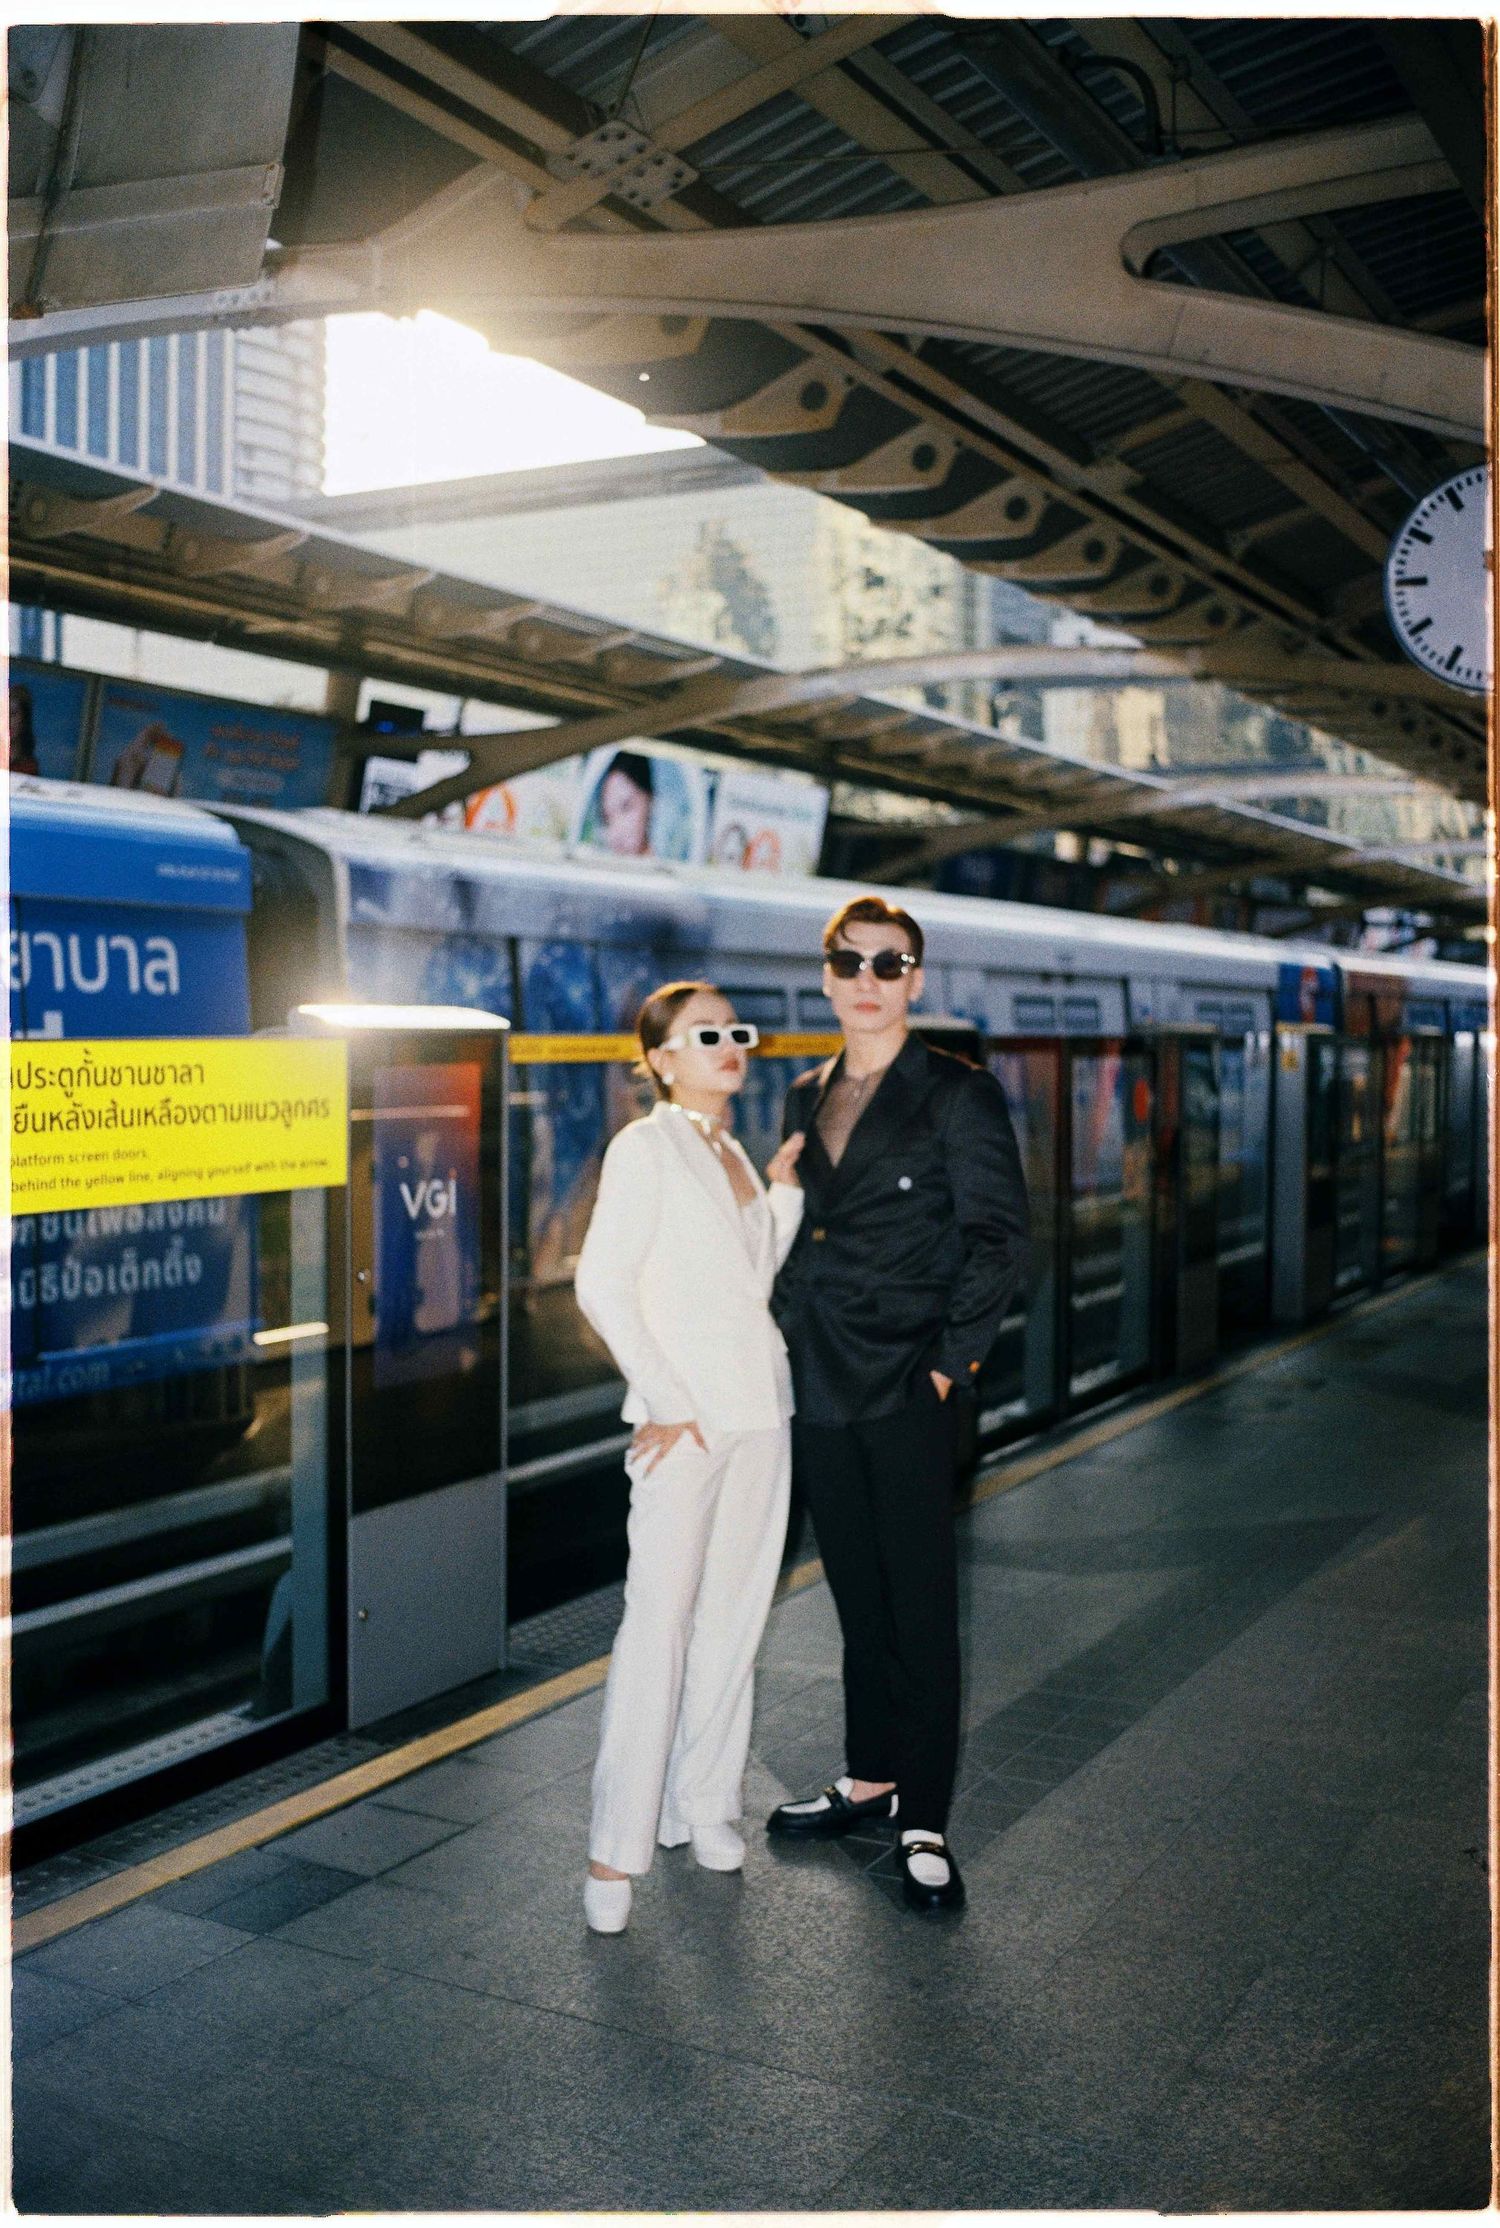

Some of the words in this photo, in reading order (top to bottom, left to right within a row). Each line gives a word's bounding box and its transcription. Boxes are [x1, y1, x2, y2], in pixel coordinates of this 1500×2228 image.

[11, 1048, 206, 1099] ประตูกั้นชานชาลา
[68, 1150, 109, 1162] screen
[11, 1178, 57, 1192] behind
[60, 1176, 81, 1188] the
[85, 1174, 125, 1189] yellow
[157, 1168, 204, 1182] aligning
[207, 1163, 253, 1179] yourself
